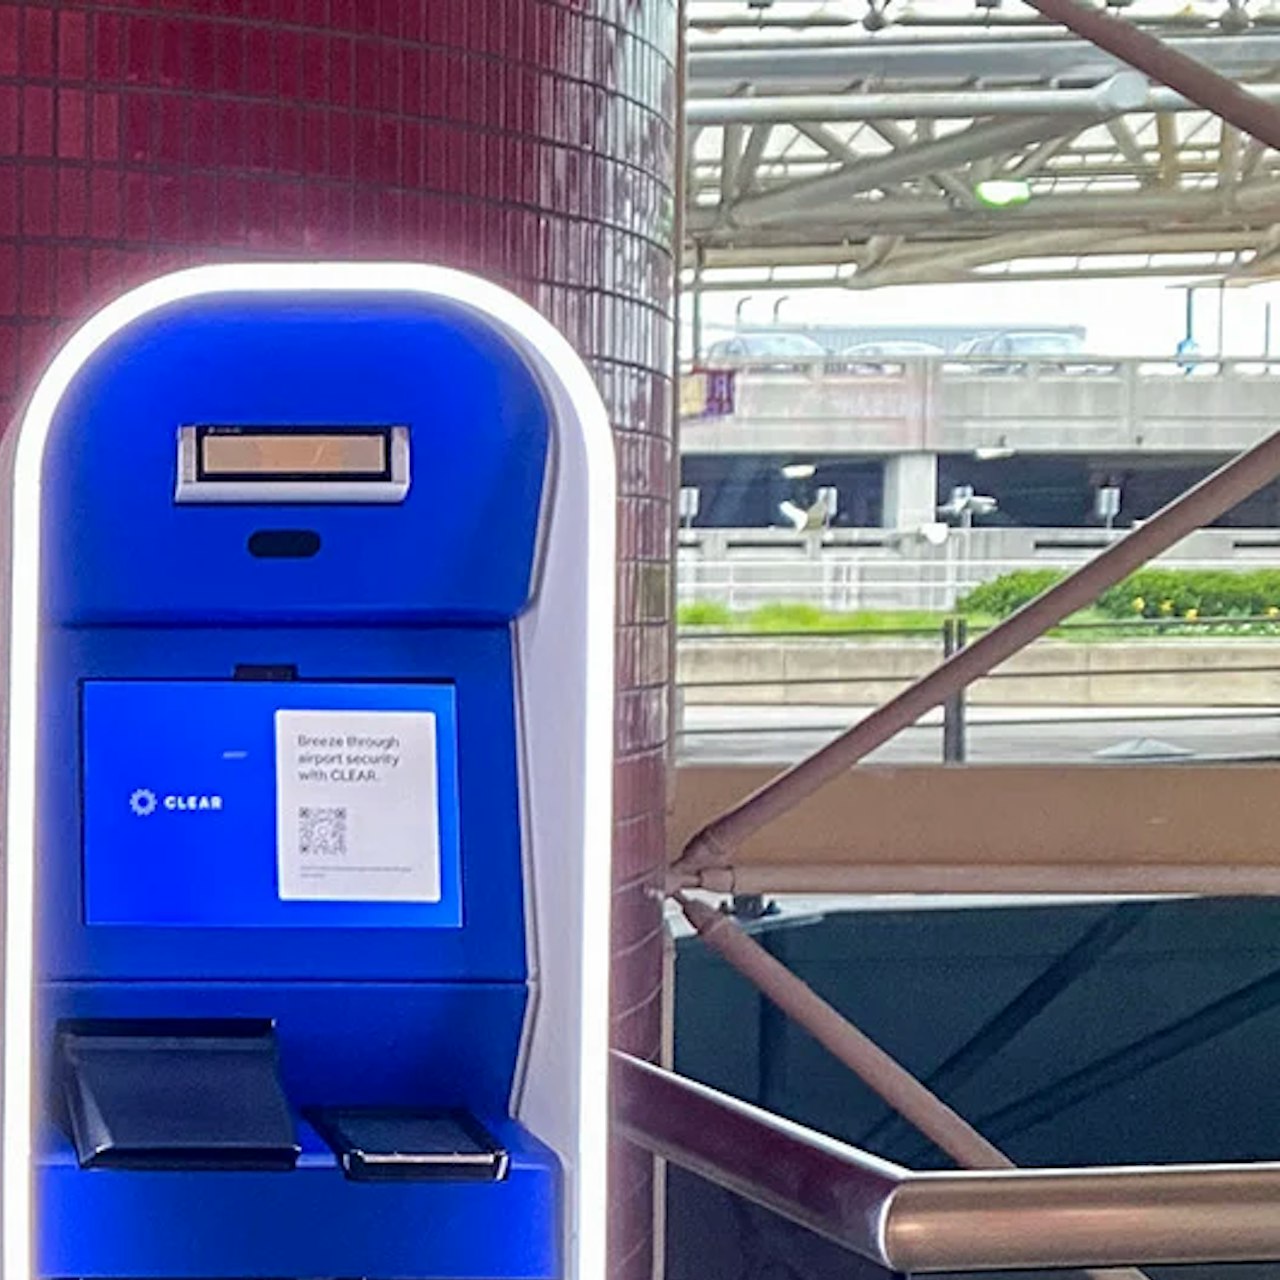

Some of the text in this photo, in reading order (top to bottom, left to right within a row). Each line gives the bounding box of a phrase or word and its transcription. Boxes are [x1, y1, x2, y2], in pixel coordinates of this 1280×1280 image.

[298, 735, 400, 750] Breeze through
[298, 753, 400, 767] airport security
[298, 769, 327, 781] with
[164, 795, 223, 809] CLEAR
